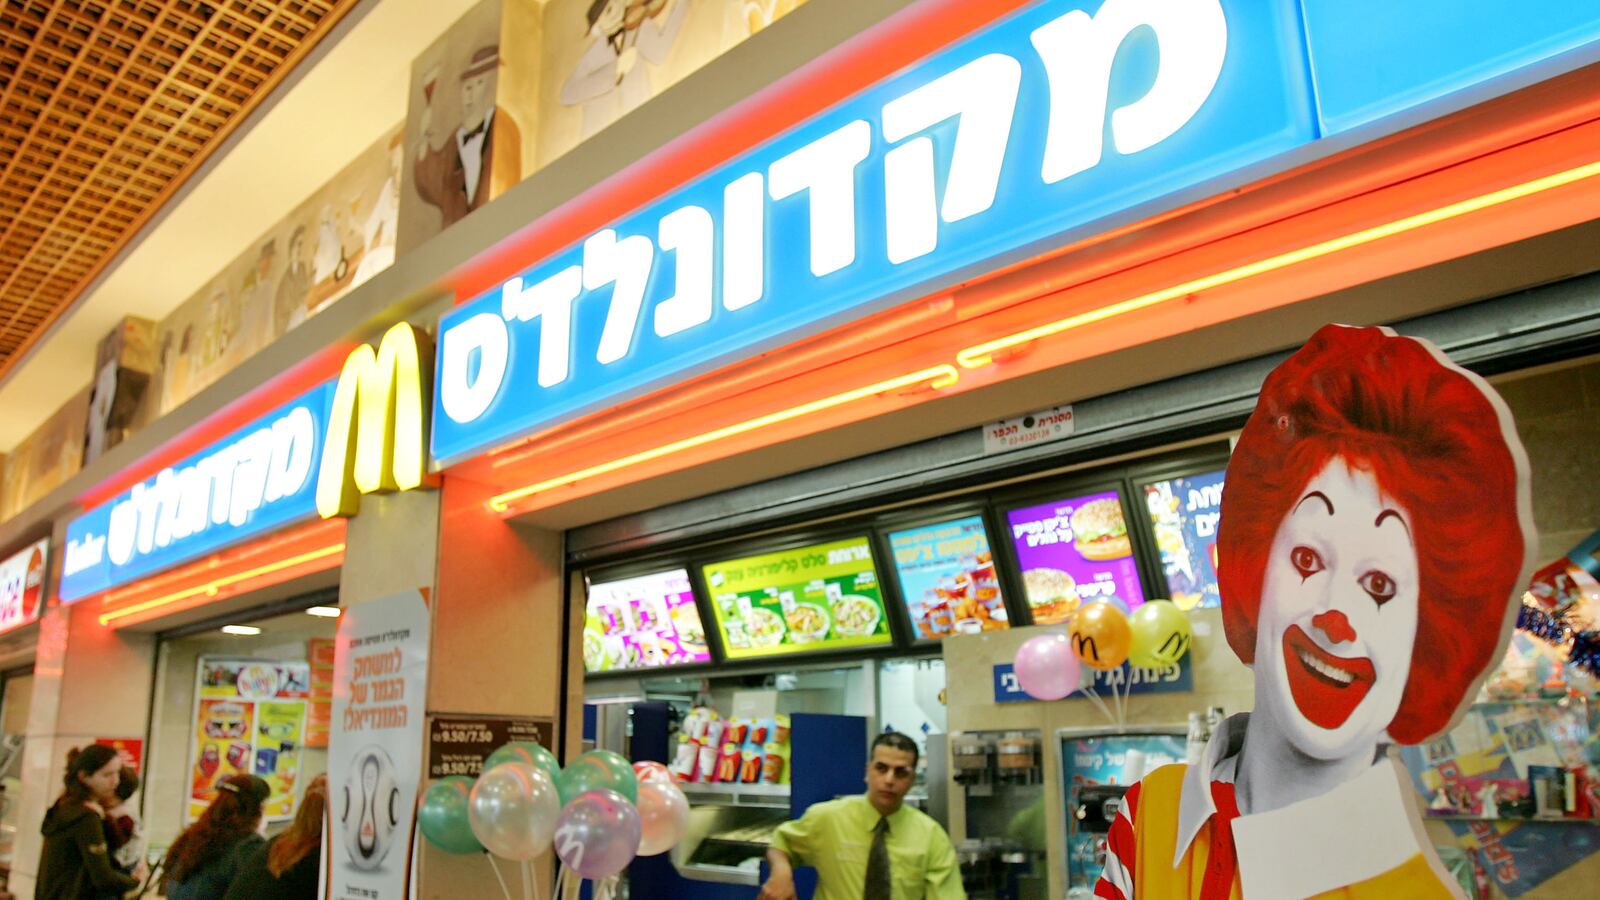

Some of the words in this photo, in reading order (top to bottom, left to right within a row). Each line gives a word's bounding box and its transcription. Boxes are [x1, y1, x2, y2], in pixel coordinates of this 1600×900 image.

[440, 0, 1229, 425] מקדונלד'ס
[353, 646, 403, 681] למשחק
[348, 681, 368, 706] של
[371, 678, 405, 703] הגמר
